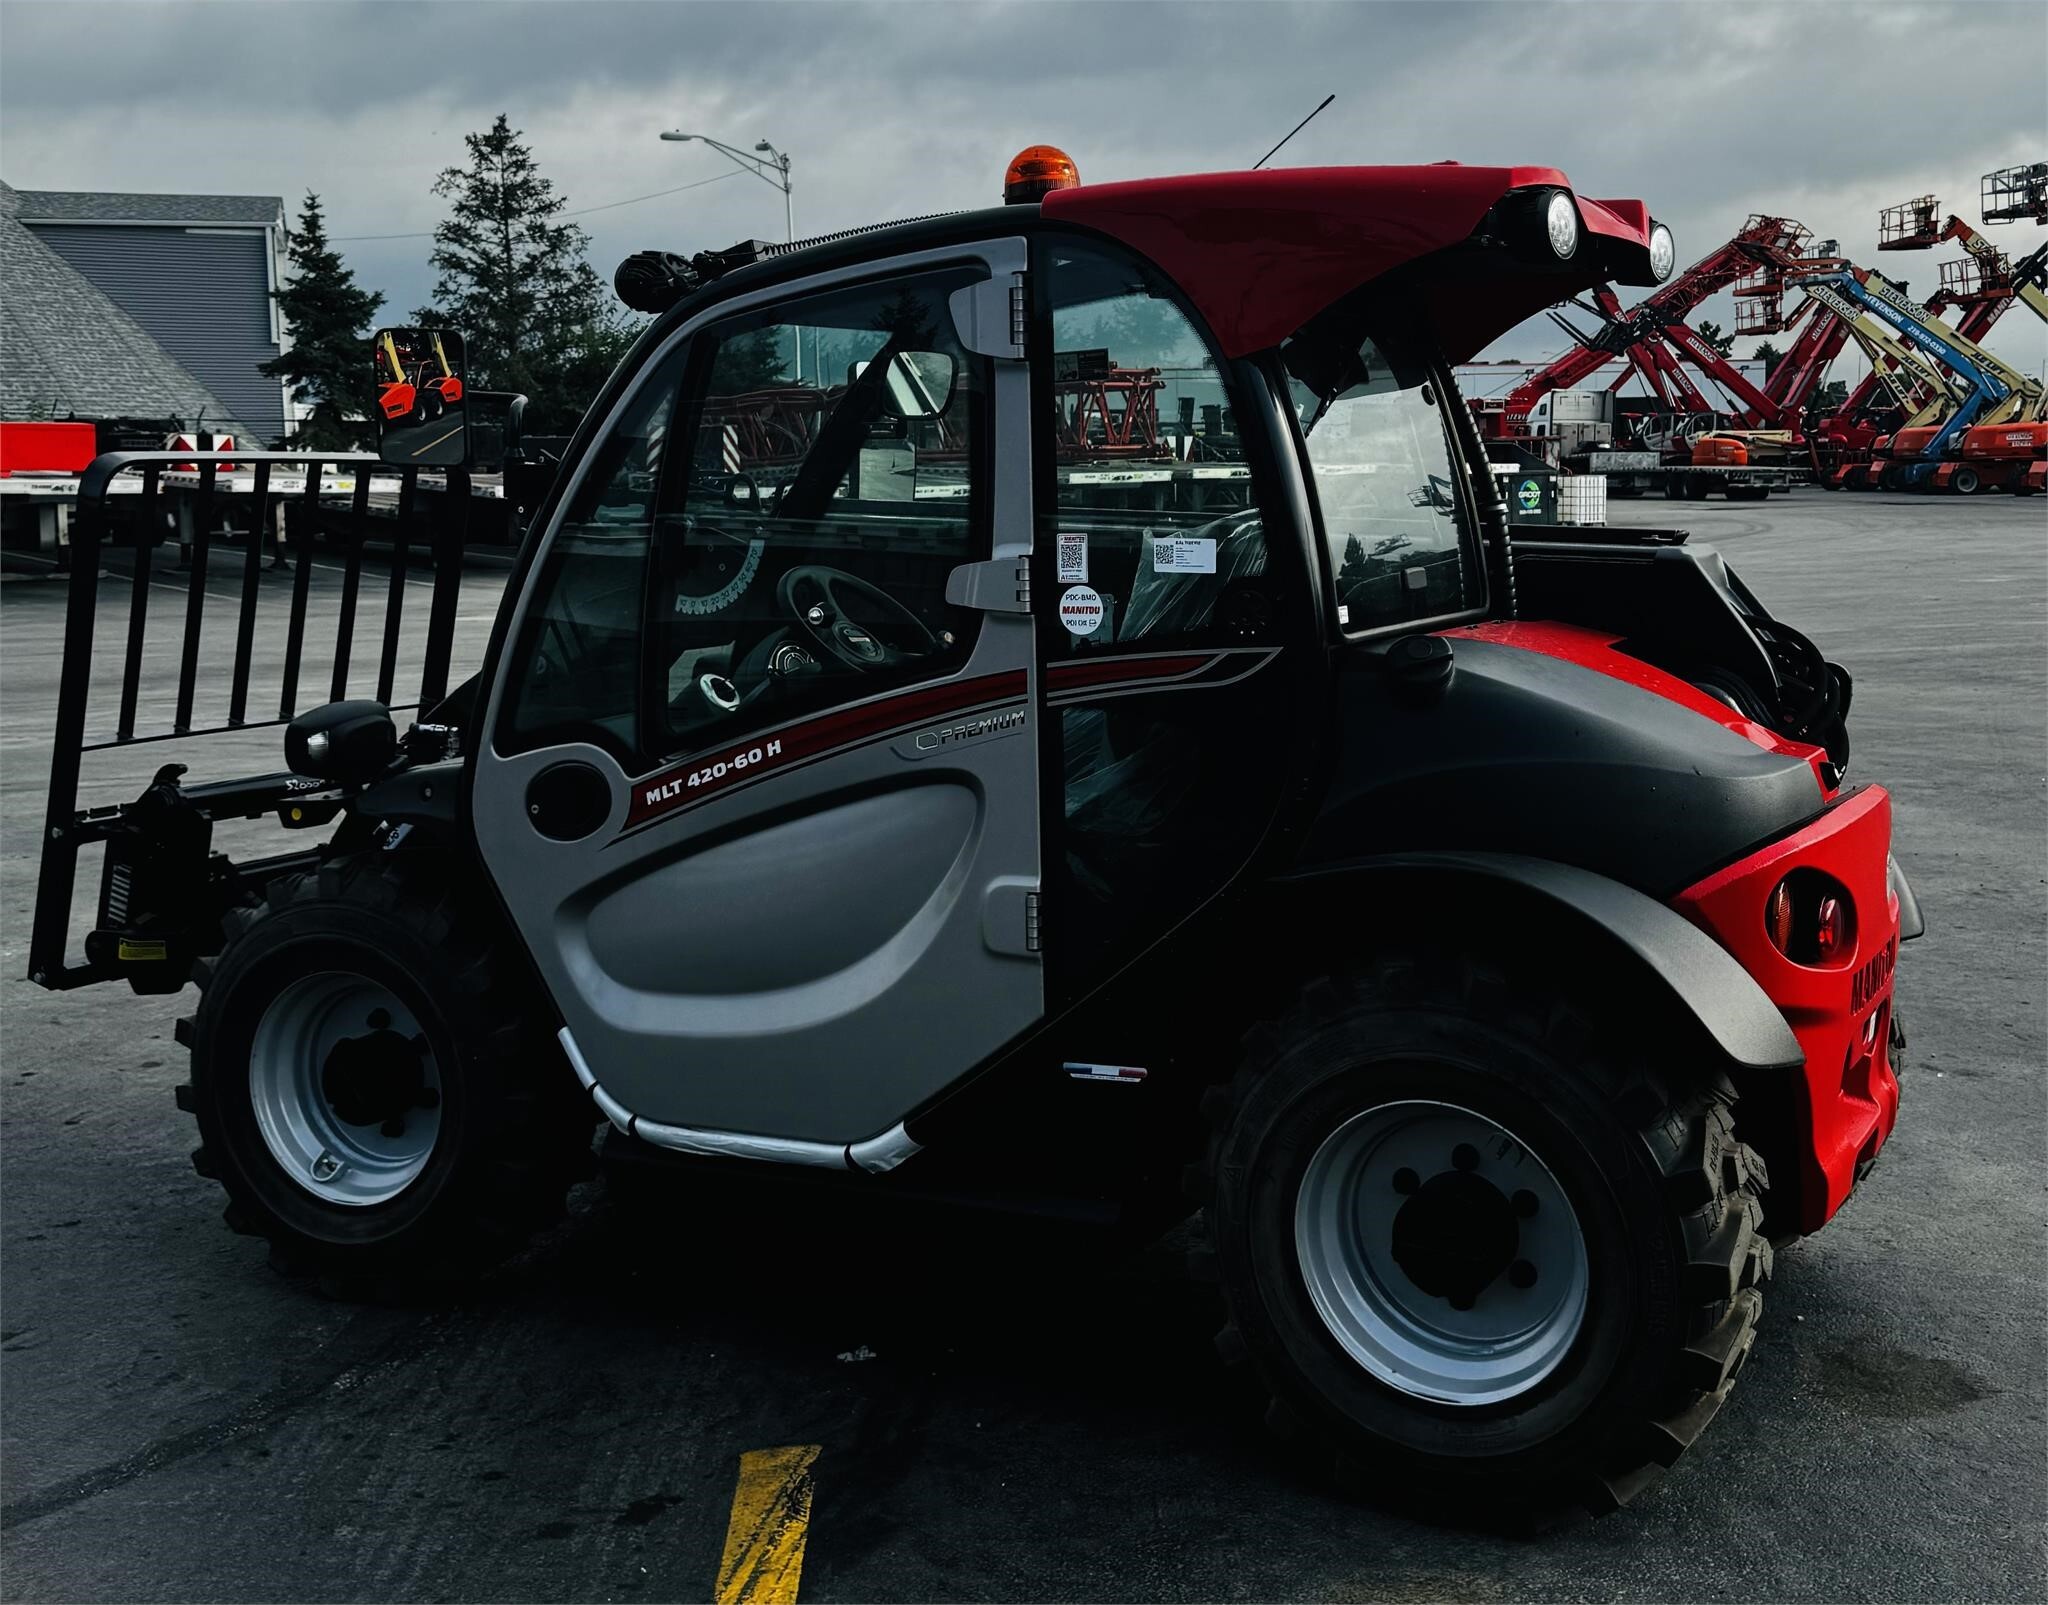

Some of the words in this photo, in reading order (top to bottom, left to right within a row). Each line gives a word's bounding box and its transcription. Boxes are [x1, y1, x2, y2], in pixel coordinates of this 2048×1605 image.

[1813, 286, 1860, 322] STEVENSON
[1863, 292, 1904, 323] STEVENSON
[1880, 286, 1931, 323] STEVENSON
[1062, 605, 1101, 614] MANITOU
[940, 710, 1026, 746] PREMIUM
[646, 779, 684, 806] MLT
[687, 747, 763, 789] 420-60
[768, 739, 783, 757] H
